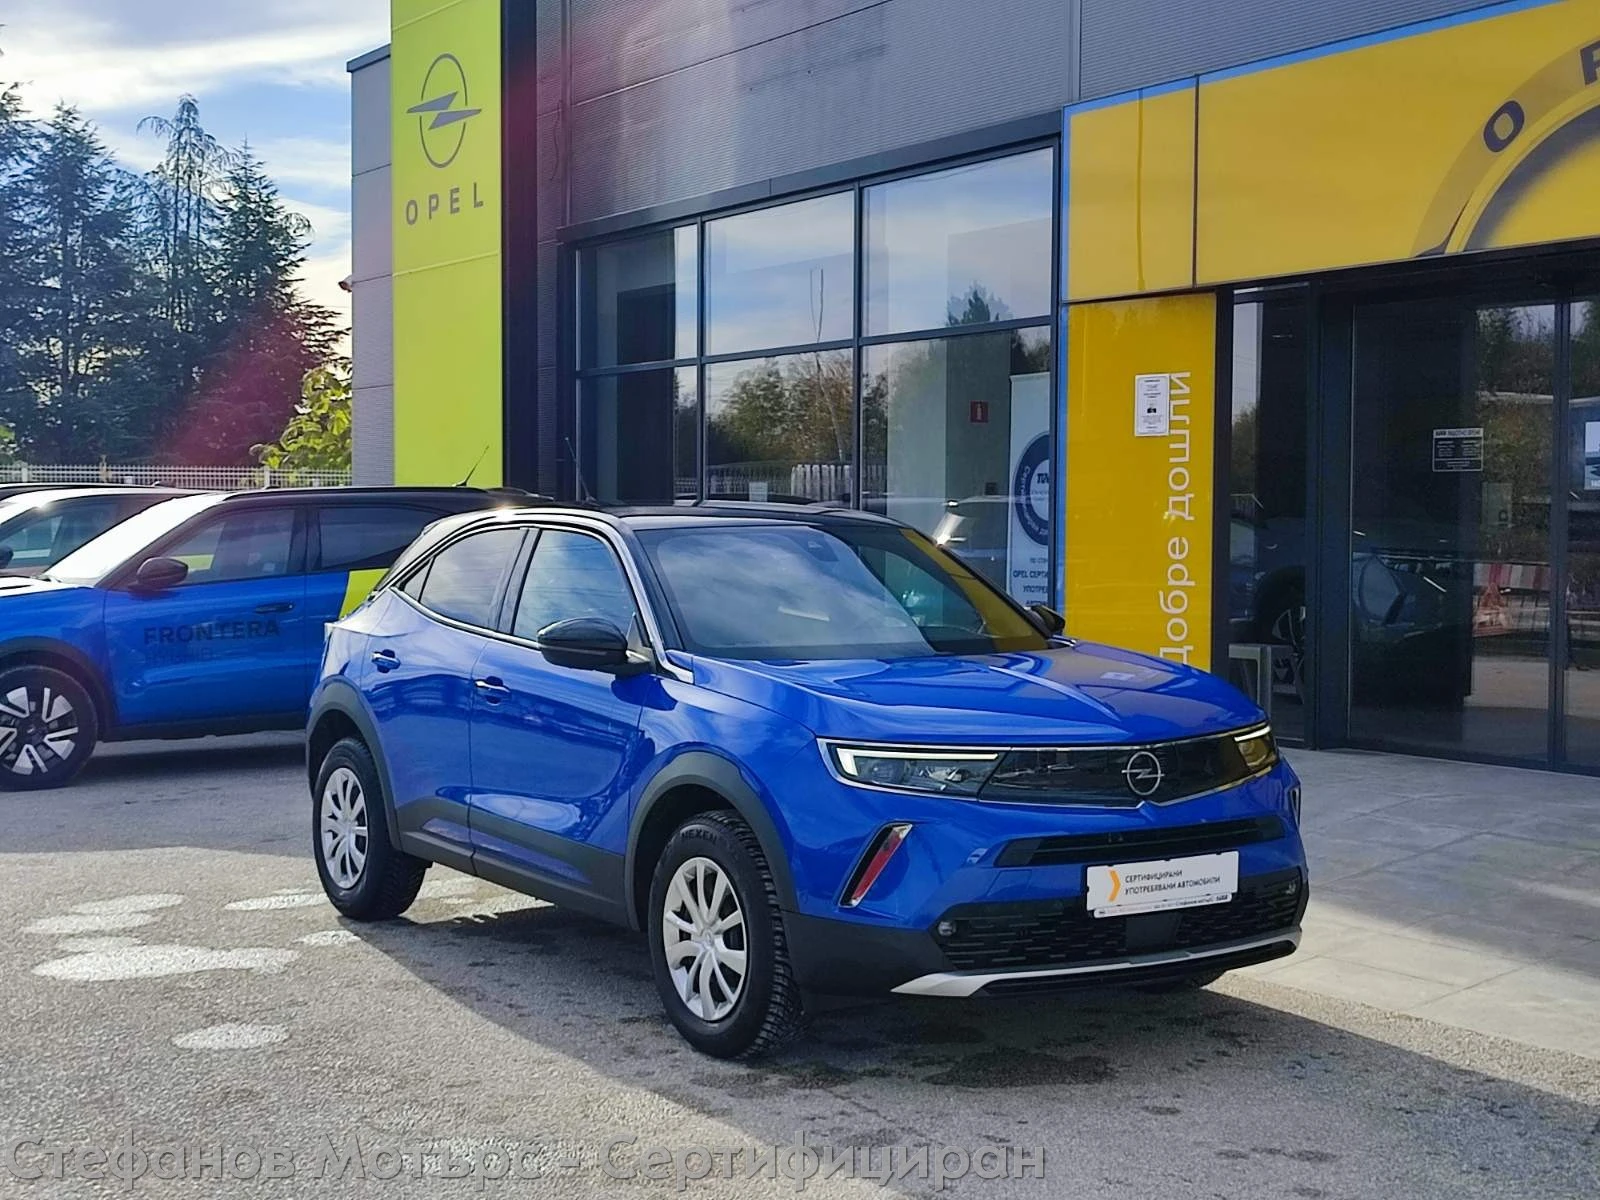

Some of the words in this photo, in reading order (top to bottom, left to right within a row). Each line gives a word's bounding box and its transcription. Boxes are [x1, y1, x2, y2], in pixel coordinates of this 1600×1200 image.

[406, 181, 484, 226] OPEL
[1167, 371, 1195, 520] дошли
[1159, 536, 1195, 665] Добре
[143, 619, 281, 645] FRONTERA
[1125, 869, 1183, 883] СЕРТИФИЦИРАНИ
[1125, 882, 1177, 896] УПОТРЕБЯВАНИ
[1177, 876, 1221, 889] АВТОМОБИЛИ
